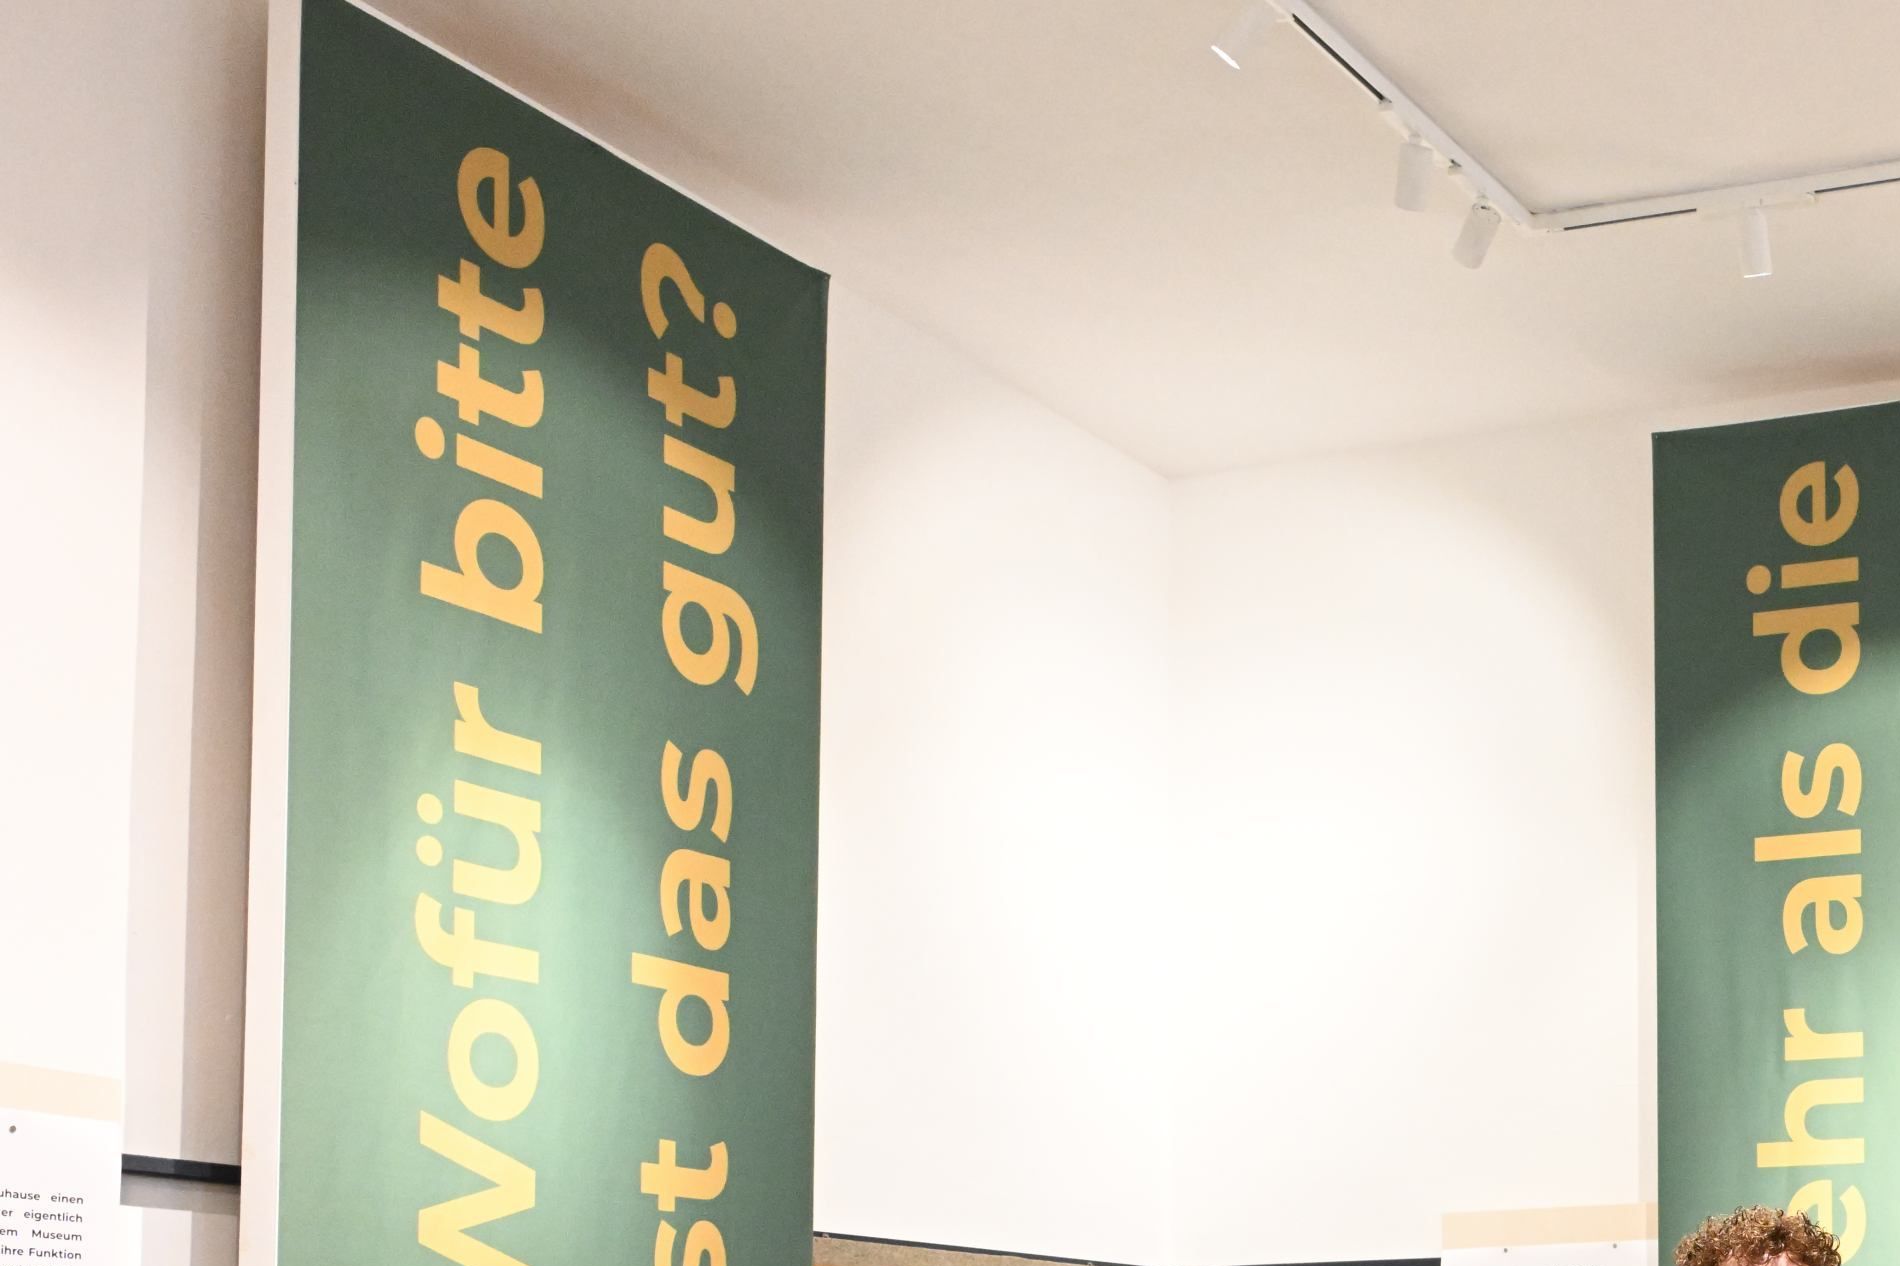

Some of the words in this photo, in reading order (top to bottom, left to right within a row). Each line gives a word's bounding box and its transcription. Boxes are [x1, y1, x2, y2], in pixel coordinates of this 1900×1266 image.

[414, 146, 546, 636] bitte
[640, 241, 760, 698] gut?
[1746, 460, 1861, 696] die
[631, 740, 734, 1078] das
[1754, 742, 1864, 955] als
[0, 1244, 24, 1256] ihre
[28, 1247, 82, 1260] Funktion
[23, 1211, 83, 1223] eigentlich
[31, 1228, 83, 1242] Museum
[50, 1192, 84, 1205] einen
